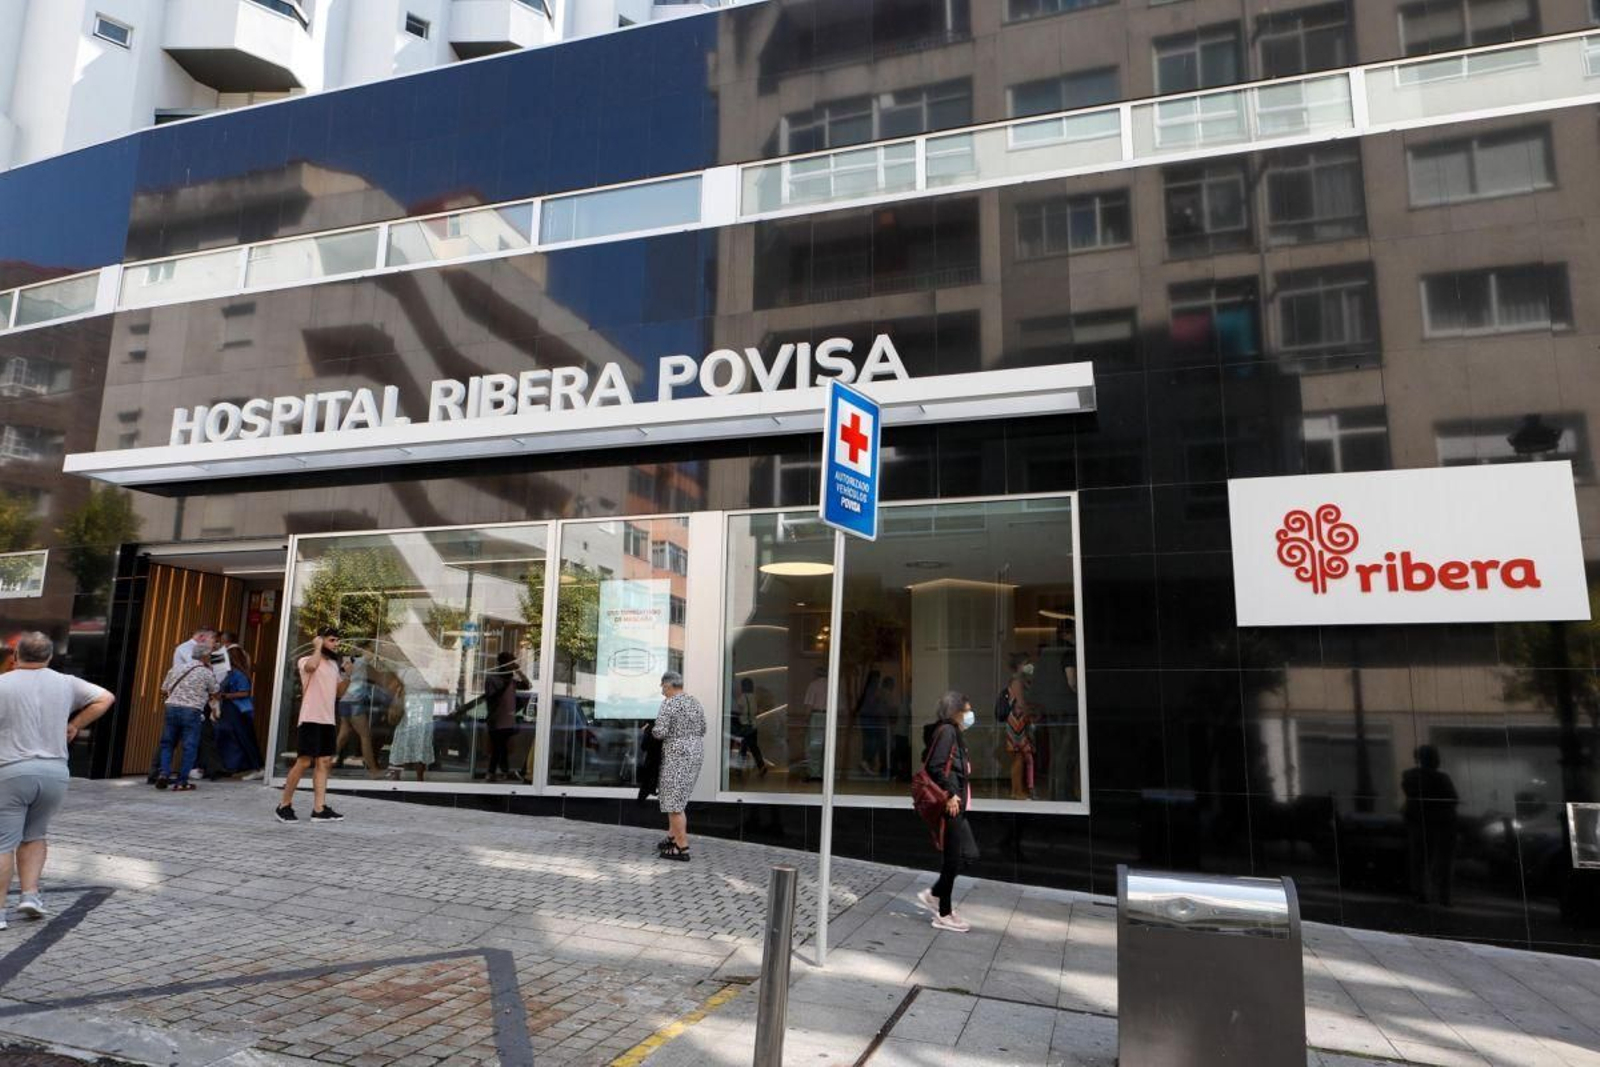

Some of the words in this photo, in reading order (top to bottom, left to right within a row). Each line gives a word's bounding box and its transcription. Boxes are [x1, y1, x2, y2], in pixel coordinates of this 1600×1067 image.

[169, 385, 411, 446] HOSPITAL
[428, 361, 634, 423] RIBERA
[658, 334, 910, 403] POVISA
[835, 471, 870, 493] AUTORIZADO
[1355, 551, 1541, 593] ribera
